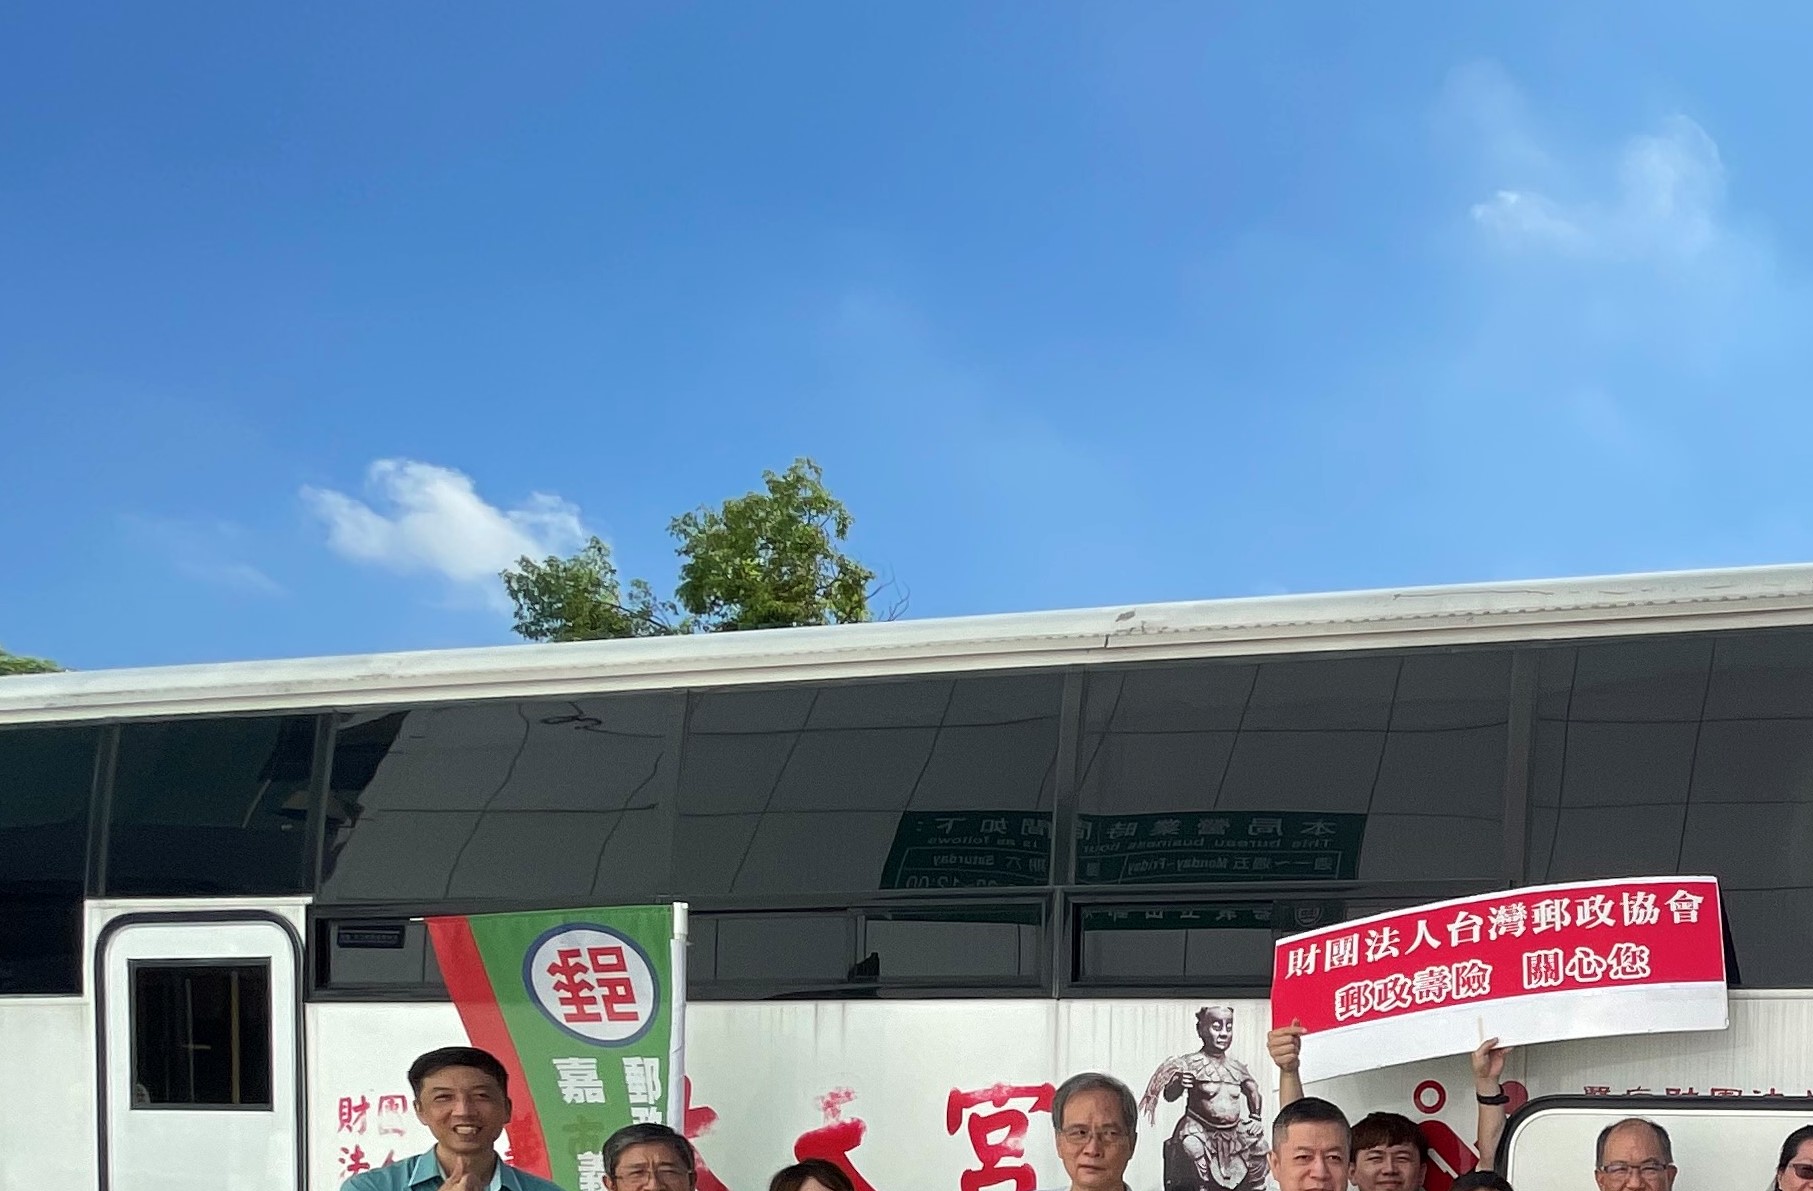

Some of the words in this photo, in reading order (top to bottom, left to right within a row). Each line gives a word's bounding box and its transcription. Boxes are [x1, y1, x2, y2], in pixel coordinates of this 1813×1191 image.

[1284, 889, 1705, 980] 財團法人台灣郵政協會
[1335, 958, 1493, 1022] 郵政壽險
[1521, 942, 1651, 990] 關心您
